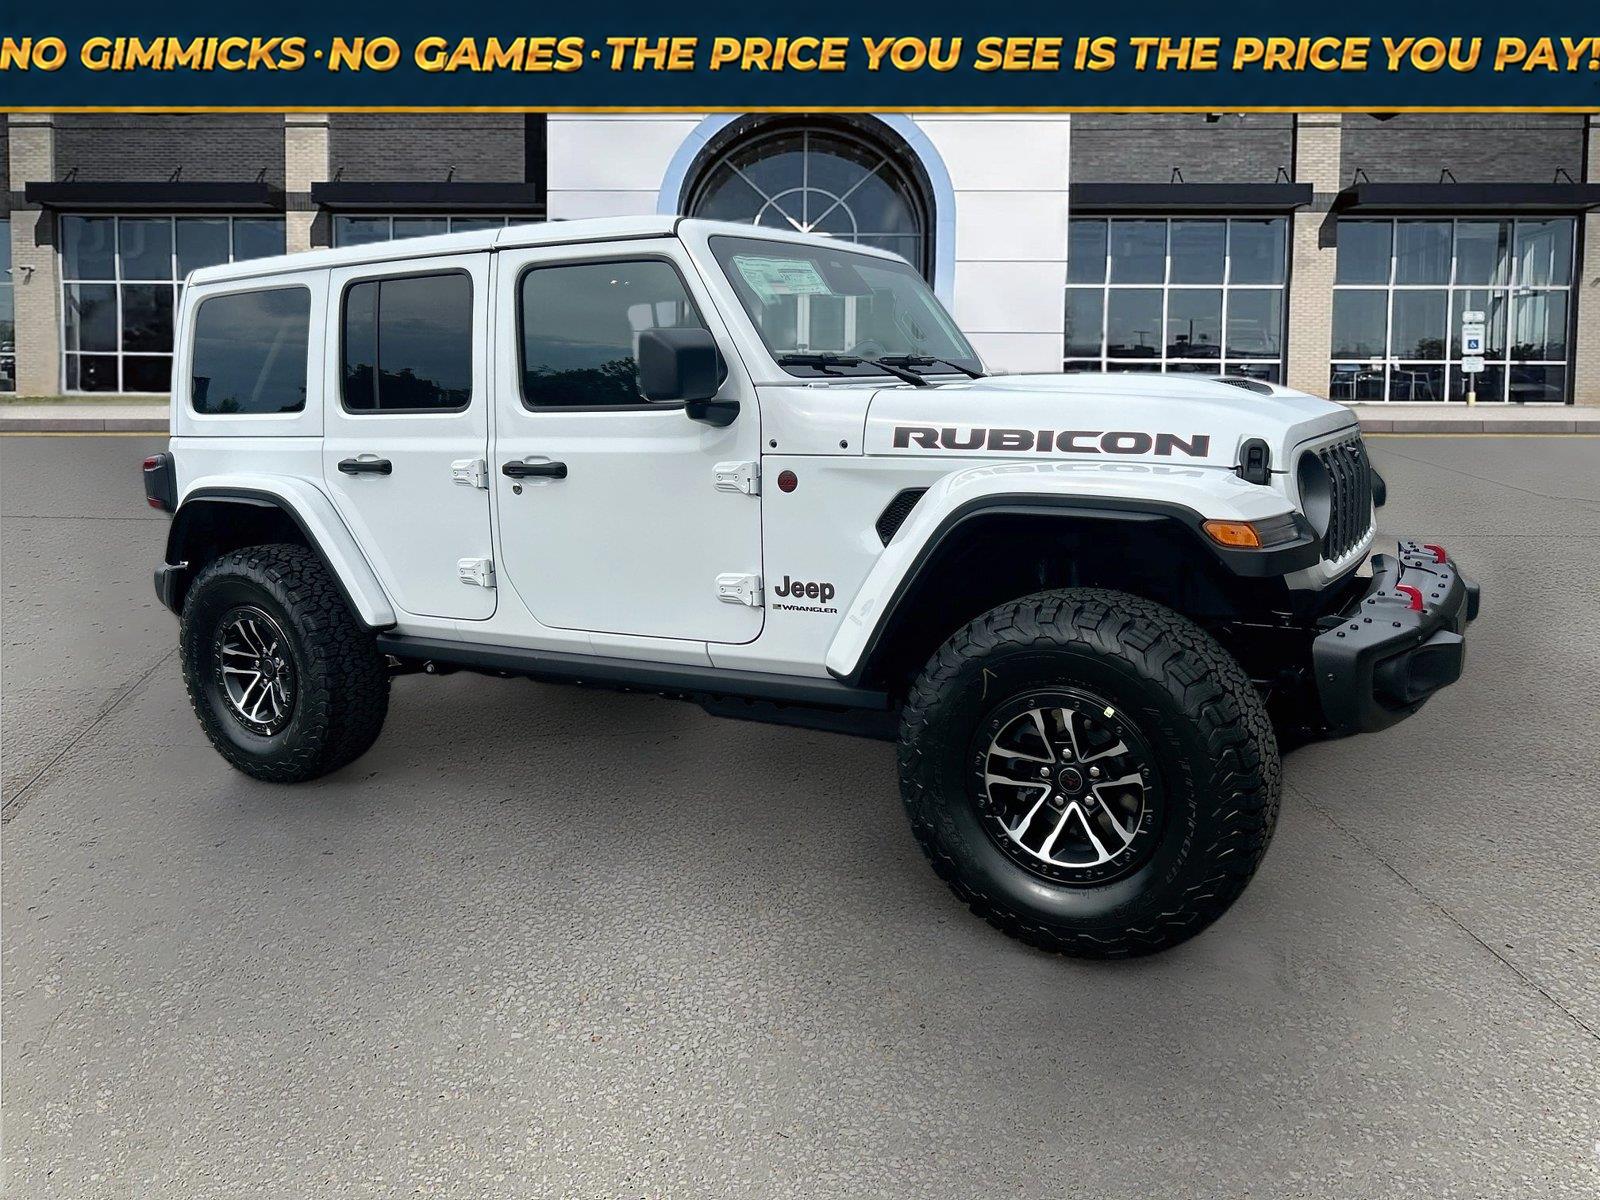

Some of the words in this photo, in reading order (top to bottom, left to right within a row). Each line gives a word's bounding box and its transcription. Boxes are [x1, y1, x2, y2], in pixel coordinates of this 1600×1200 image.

[893, 426, 1210, 457] RUBICON
[774, 575, 835, 604] Jeep
[782, 604, 838, 614] WRANGLER
